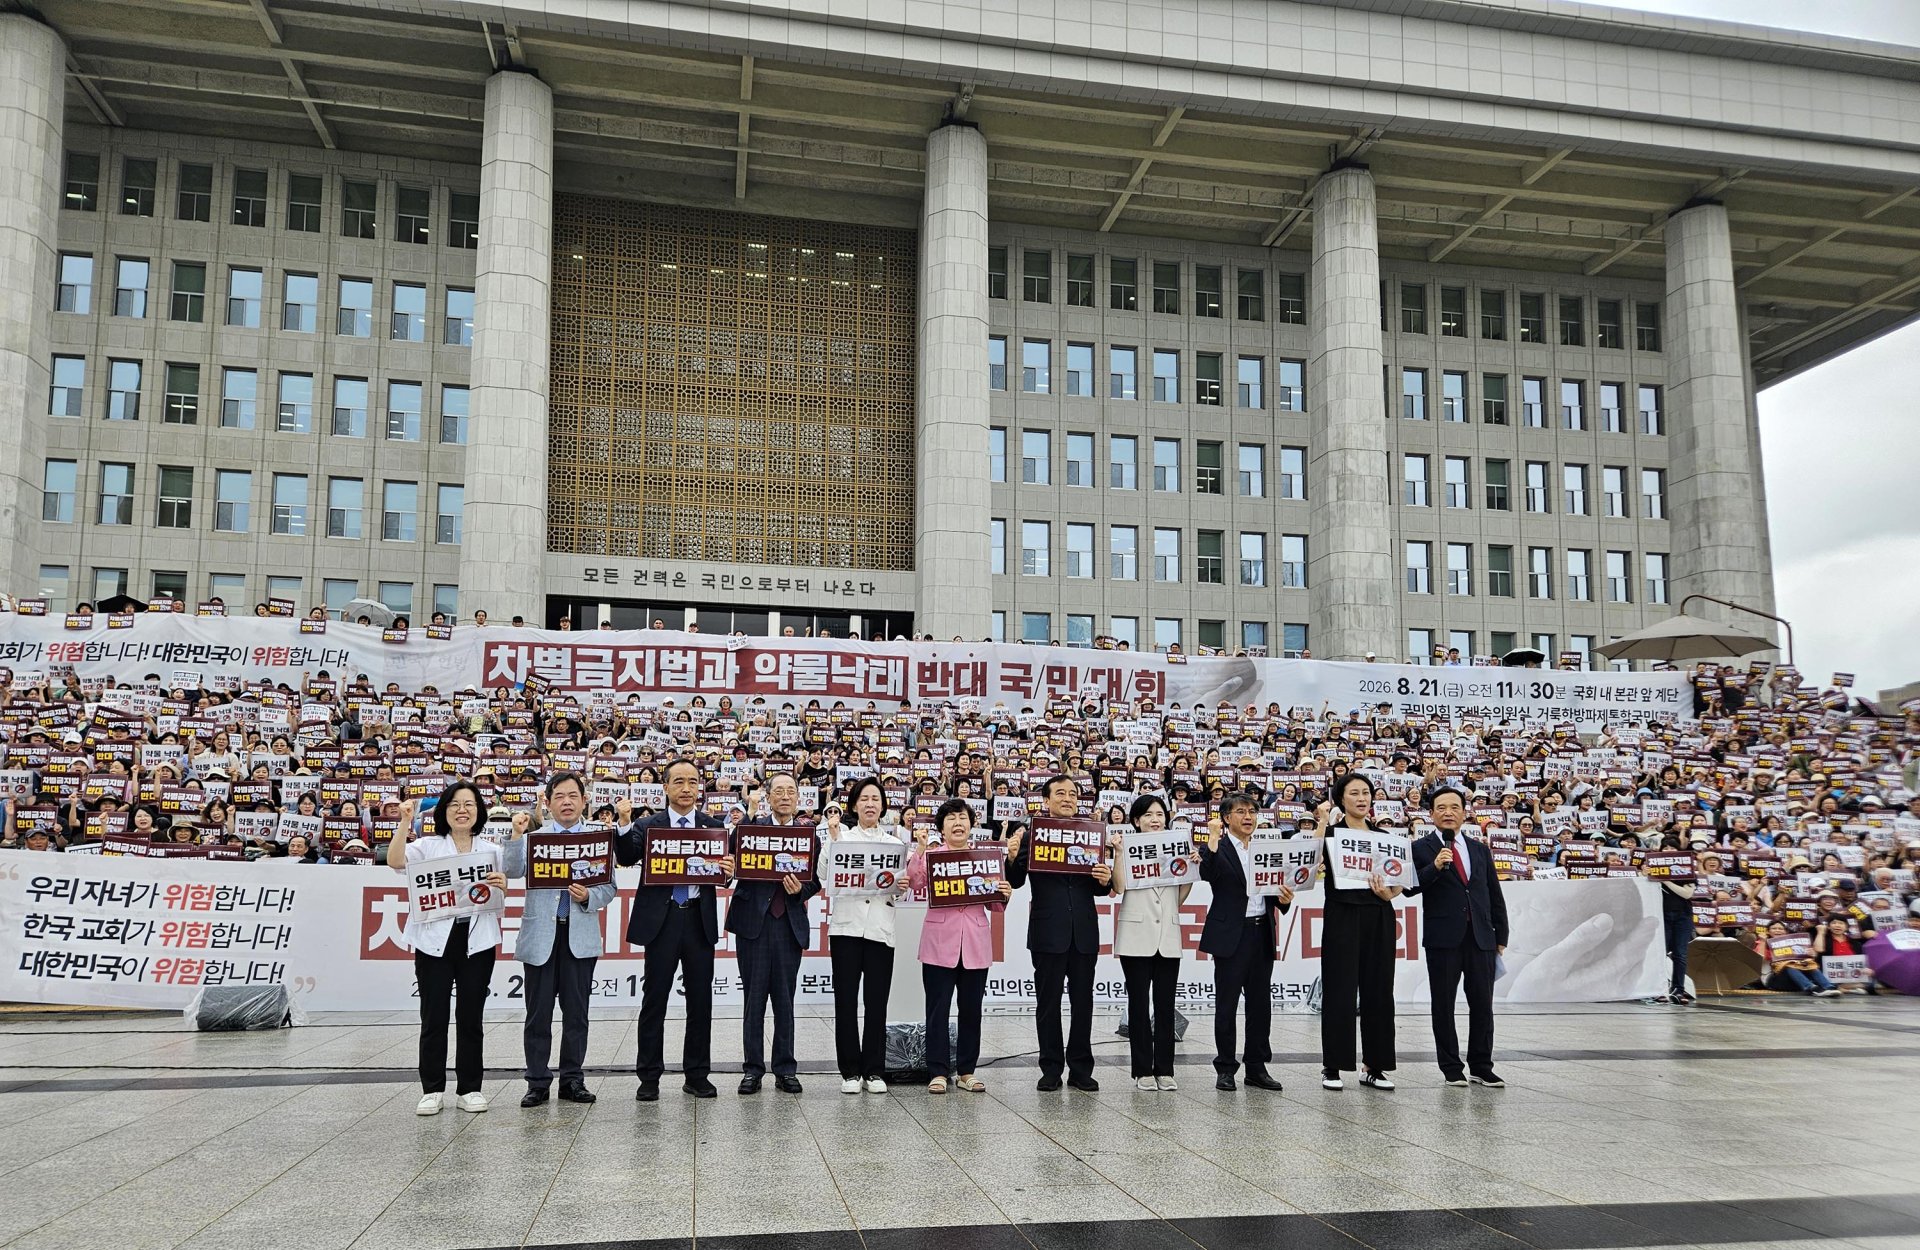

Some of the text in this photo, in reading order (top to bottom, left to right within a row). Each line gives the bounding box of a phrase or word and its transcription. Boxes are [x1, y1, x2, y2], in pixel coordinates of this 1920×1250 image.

[584, 568, 876, 596] 모든 권력은 국민으로부터 나온다
[45, 642, 150, 662] 위험합니다!
[152, 643, 248, 665] 대한민국이
[252, 646, 350, 668] 위험합니다!
[488, 644, 1166, 704] 차별금지법과 약물낙태 반대 국/민/대/회
[1359, 680, 1393, 693] 2026.
[1398, 678, 1414, 695] 8.
[1468, 684, 1492, 697] 오전
[1497, 682, 1526, 698] 11시
[1531, 682, 1566, 700] 30분
[1573, 685, 1596, 700] 국회
[1600, 687, 1611, 701] 내
[1614, 688, 1638, 702] 본관
[1641, 688, 1652, 702] 앞
[1655, 688, 1678, 702] 계단
[1400, 703, 1450, 720] 국민의힘
[1538, 708, 1660, 725] 거룩한방파제통합국민
[162, 793, 201, 801] 차별금지법
[234, 794, 250, 802] 반대
[506, 786, 536, 794] 차별금지법
[162, 801, 179, 809] 반대
[17, 810, 55, 819] 차별금지법
[17, 820, 34, 828] 반대
[282, 820, 319, 831] 약물 낙태
[281, 829, 298, 837] 반대
[325, 830, 340, 838] 반대
[1035, 827, 1101, 846] 차별금지법
[534, 842, 608, 859] 차별금지법
[651, 840, 724, 855] 차별금지법
[741, 835, 810, 852] 차별금지법
[1128, 840, 1190, 860] 약물 낙태
[1341, 838, 1406, 860] 약물 낙태
[741, 854, 772, 870] 반대
[835, 854, 900, 870] 약물 낙태
[1034, 846, 1064, 863] 반대
[1254, 851, 1315, 868] 약물 낙태
[1648, 857, 1691, 866] 차별금지법
[534, 862, 568, 878] 반대
[651, 858, 684, 875] 반대
[932, 859, 1000, 877] 차별금지법
[1131, 864, 1160, 880] 반대
[1343, 855, 1373, 872] 반대
[1650, 867, 1670, 876] 반대
[416, 864, 493, 890] 약물 낙태
[835, 873, 865, 888] 반대
[1255, 871, 1284, 886] 반대
[26, 876, 295, 913] 우리 자녀가 위험합니다!
[934, 878, 965, 897] 반대
[419, 891, 456, 912] 반대
[23, 913, 292, 950] 한국 교회가 위험합니다!
[19, 950, 284, 985] 대한민국이 위험합니다!
